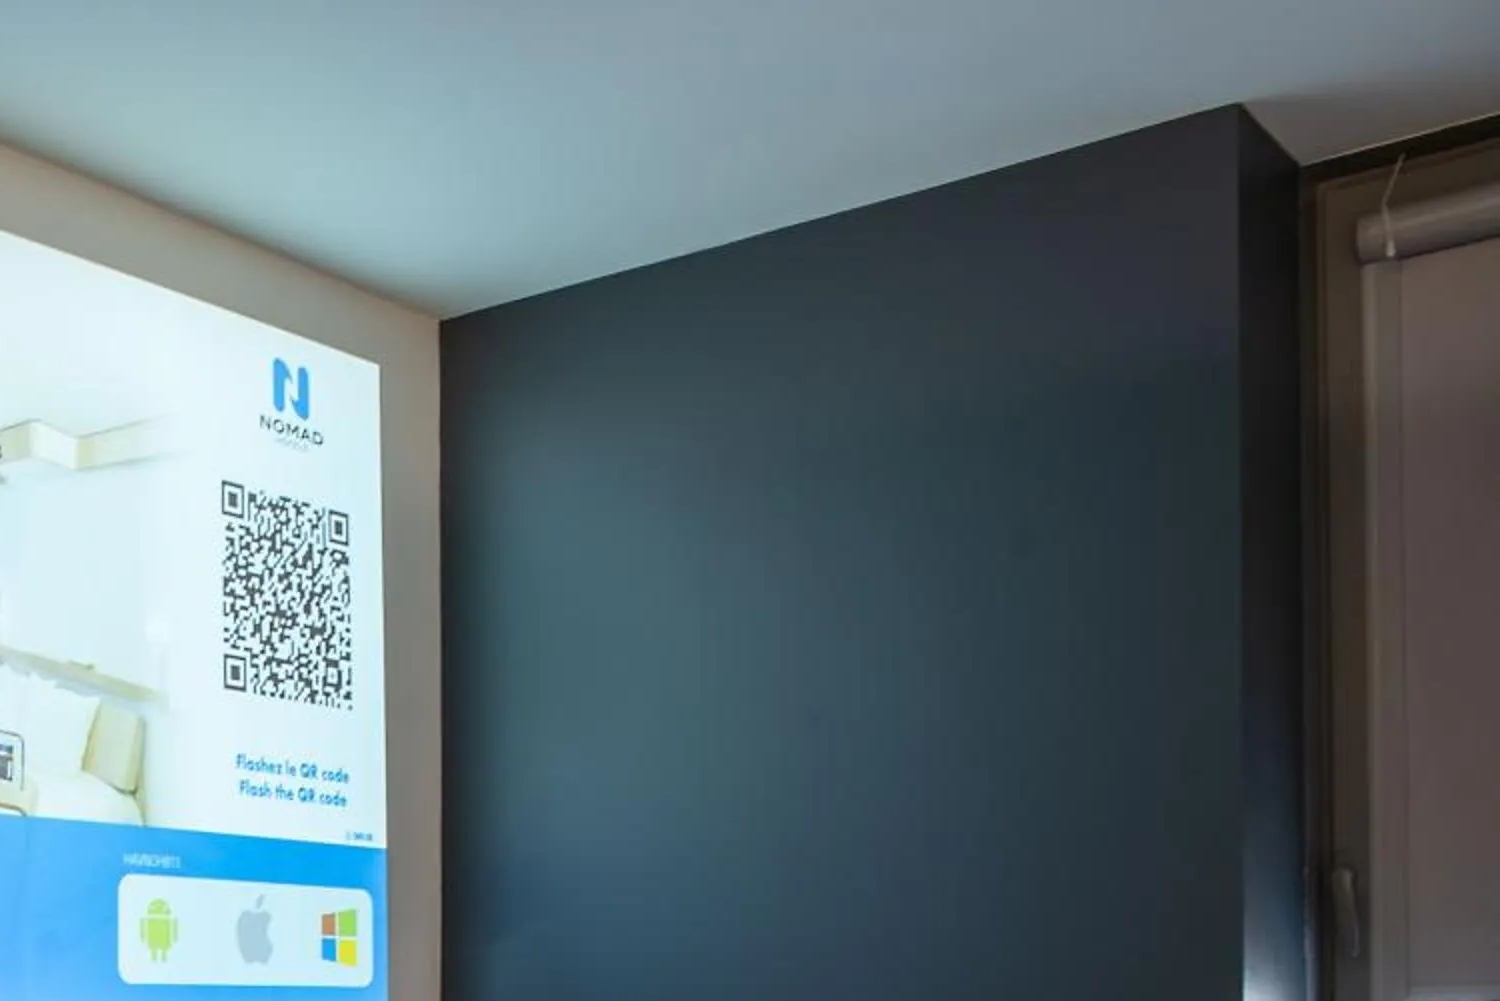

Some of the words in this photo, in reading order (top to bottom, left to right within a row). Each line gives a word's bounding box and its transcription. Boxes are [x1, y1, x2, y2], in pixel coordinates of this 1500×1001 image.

[259, 413, 324, 445] NOMAD
[236, 753, 282, 775] Flashez
[285, 759, 297, 776] le
[300, 762, 317, 778] QR
[321, 768, 349, 784] code
[239, 779, 271, 797] Flash
[275, 784, 293, 800] the
[298, 787, 315, 802] QR
[319, 790, 347, 807] code
